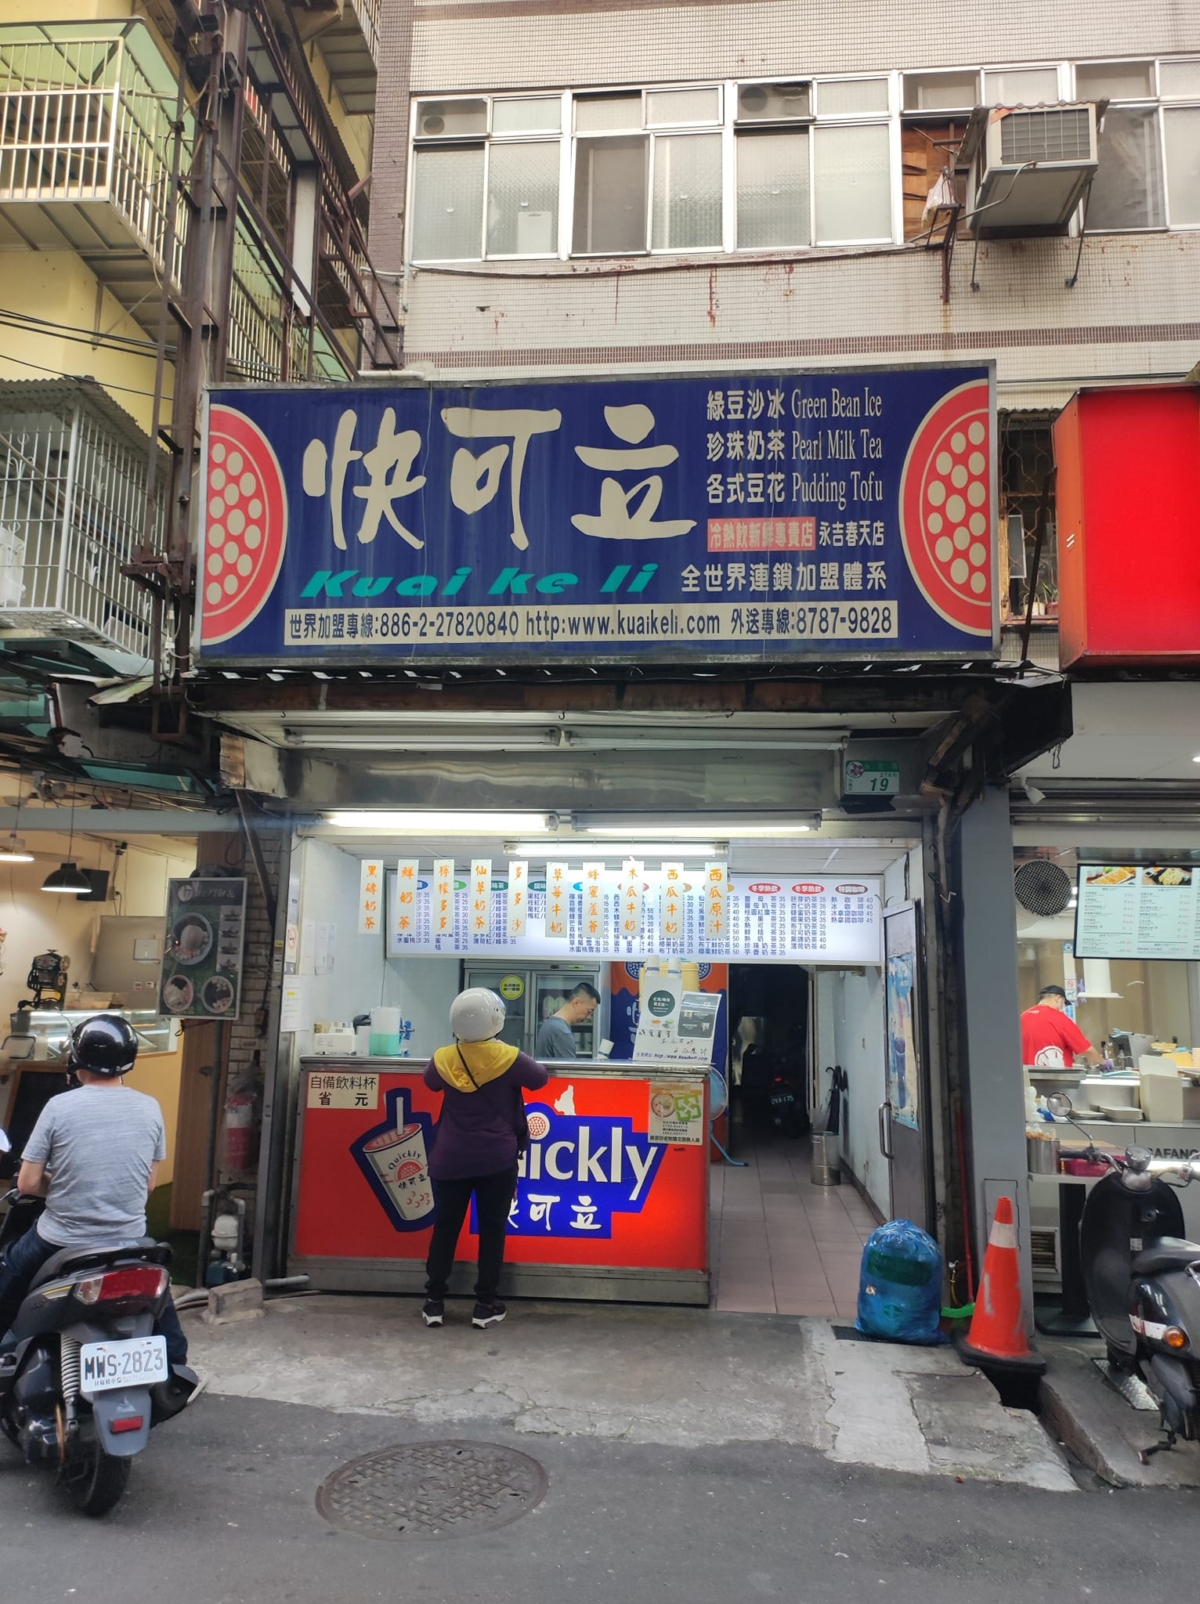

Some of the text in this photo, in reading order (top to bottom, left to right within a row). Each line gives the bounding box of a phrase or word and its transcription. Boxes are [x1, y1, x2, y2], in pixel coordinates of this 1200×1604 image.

[707, 387, 883, 421] 綠豆沙冰 Green Bean Ice
[706, 428, 883, 462] 珍珠奶茶 Pearl Milk Tea
[303, 404, 697, 551] 快可立
[706, 471, 884, 511] 各式豆花 Pudding Tofu
[819, 520, 885, 547] 永吉春天店
[300, 562, 659, 598] Kuai ke li
[680, 560, 887, 592] 全世界連鎖加盟體系
[290, 606, 892, 641] 世界加盟專線:886-2-27820840 http:www.kuaikeli.com 外送專線:8787-9828
[870, 777, 889, 792] 19
[398, 865, 415, 930] 鮮奶茶
[438, 864, 450, 931] 檸檬多多
[474, 865, 488, 930] 仙草奶茶
[550, 868, 563, 934] 草莓牛奶
[624, 867, 638, 932] 木瓜牛奶
[665, 868, 679, 934] 西瓜牛奶
[709, 868, 723, 934] 西瓜原汁
[311, 1075, 377, 1090] 自備飲料杯
[319, 1091, 369, 1106] 省 元
[388, 1150, 422, 1171] Quickly
[398, 1173, 427, 1190] 快可立
